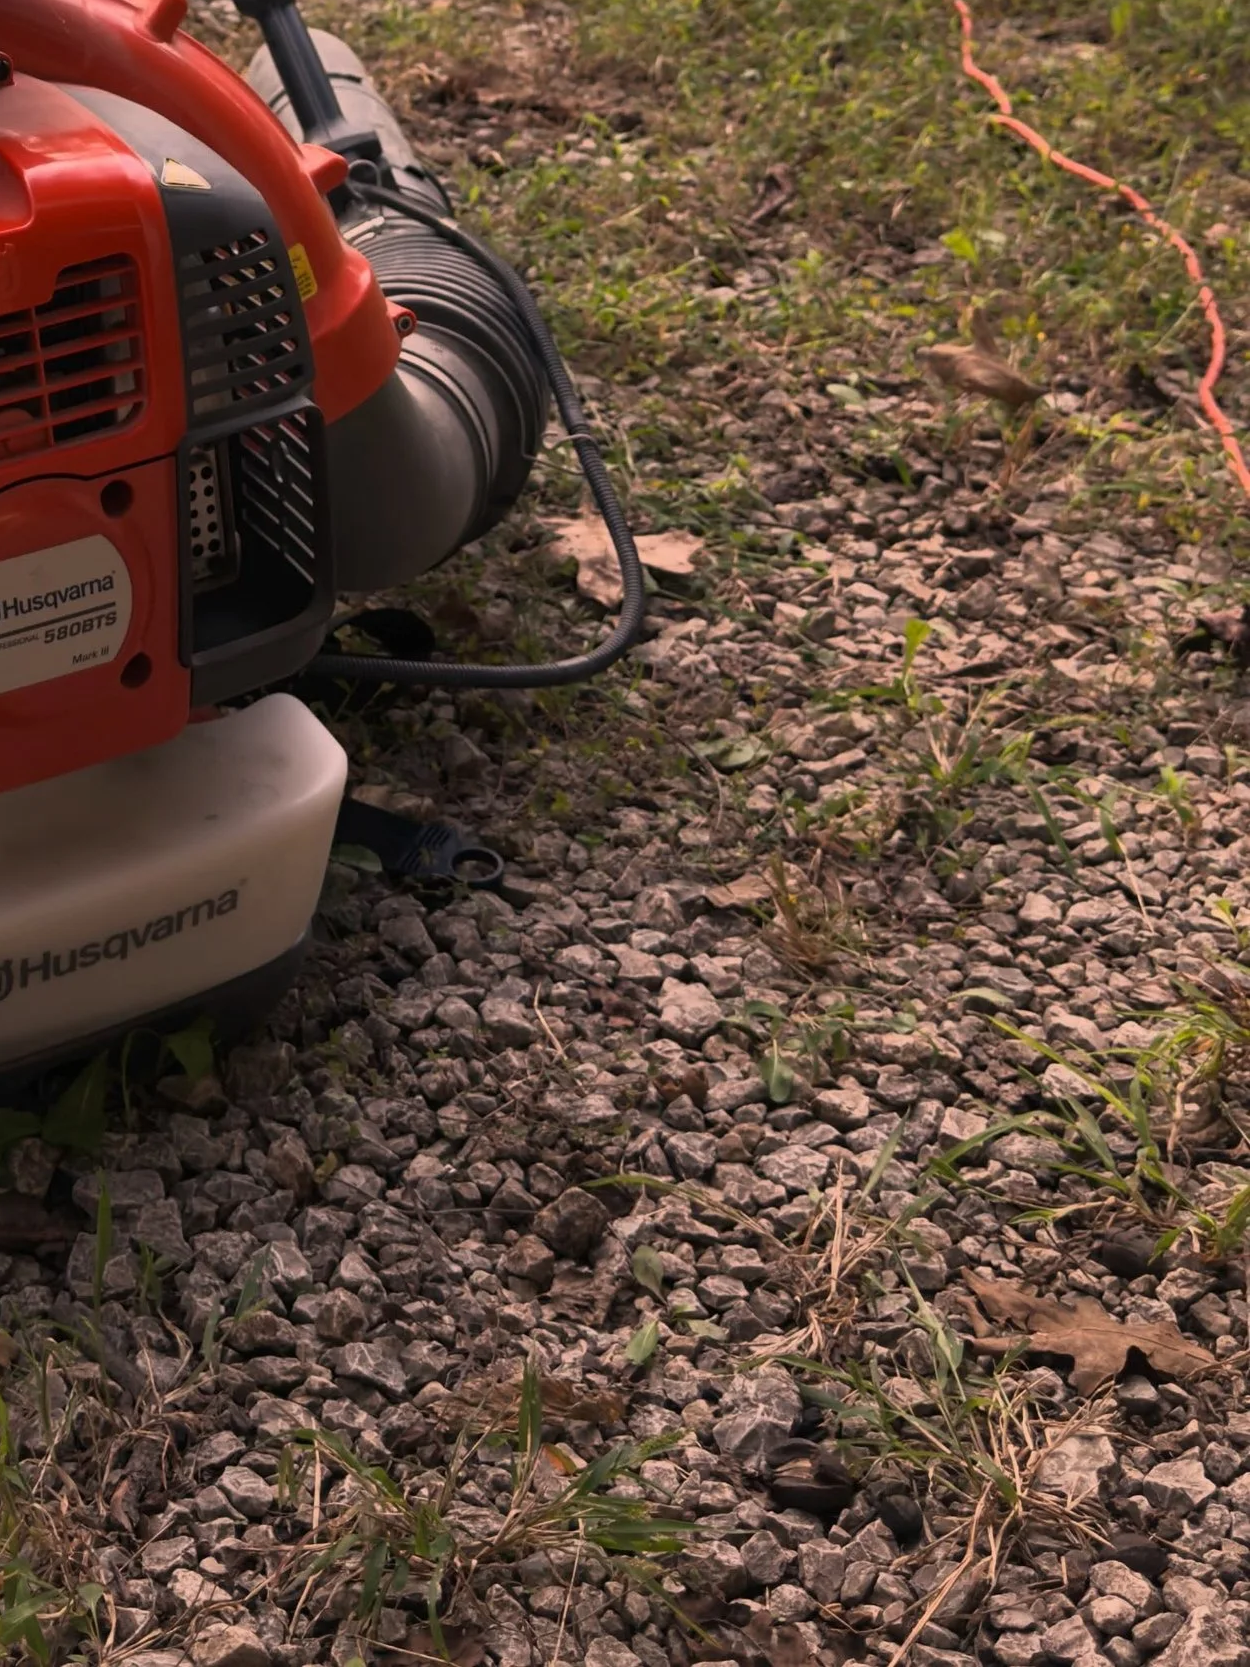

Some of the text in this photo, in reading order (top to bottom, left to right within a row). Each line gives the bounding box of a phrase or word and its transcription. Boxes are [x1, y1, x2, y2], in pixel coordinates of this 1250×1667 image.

[2, 575, 114, 618] Husqvarna
[44, 612, 117, 643] 580BTS
[72, 646, 110, 665] Mark III
[20, 888, 239, 989] Husqvarna
